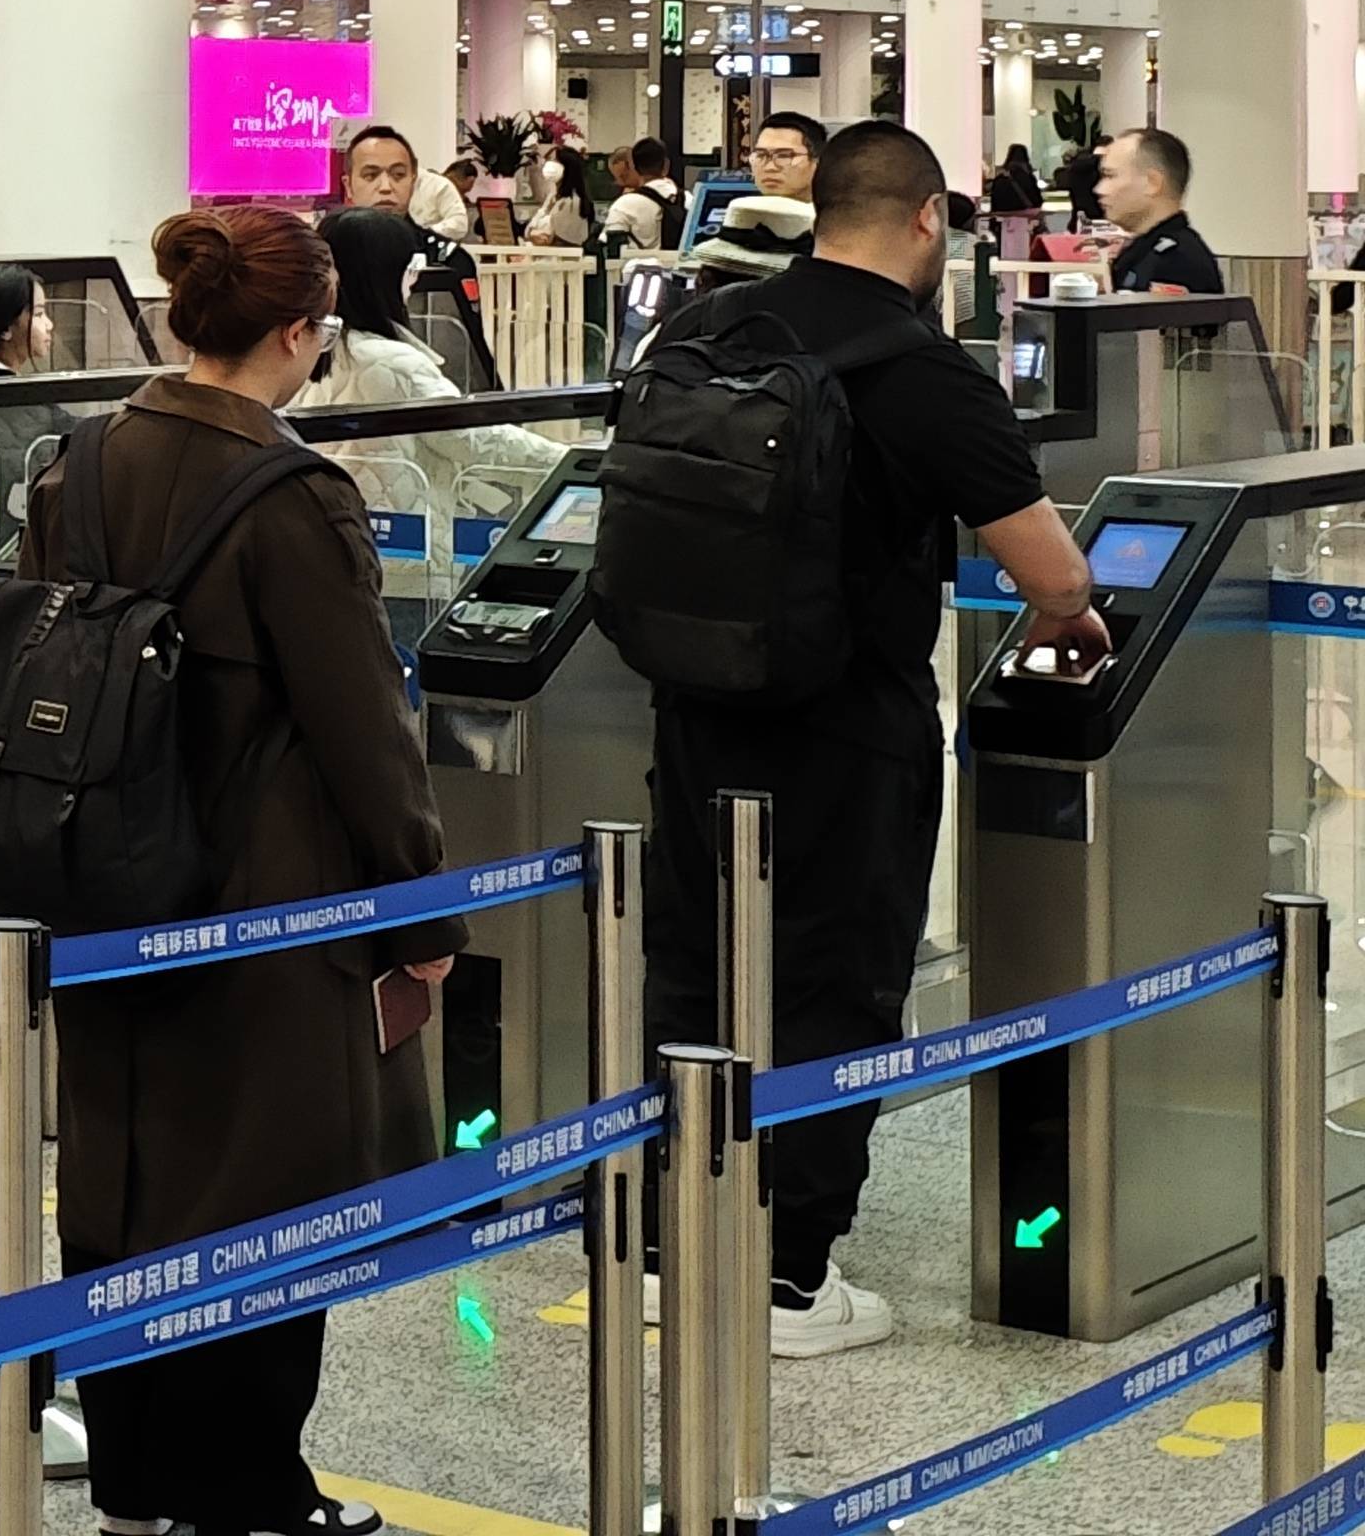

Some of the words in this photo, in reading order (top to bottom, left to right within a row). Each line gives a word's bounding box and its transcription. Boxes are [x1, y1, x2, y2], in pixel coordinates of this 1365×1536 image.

[469, 860, 545, 898] 中国移民管理
[139, 924, 227, 961] 中国移民管理
[237, 914, 280, 944] CHINA
[284, 897, 375, 937] IMMIGRATION
[1127, 963, 1194, 1008] 中国移民管理
[834, 1047, 914, 1093] 中国移民管理
[923, 1040, 962, 1068] CHINA
[965, 1013, 1046, 1057] IMMIGRATION
[497, 1121, 583, 1178] 中国移民管理
[592, 1112, 636, 1143] CHINA
[86, 1251, 200, 1318] 中国移民管理
[211, 1235, 266, 1276] CHINA
[271, 1198, 383, 1257] IMMIGRATION
[471, 1206, 545, 1248] 中国移民管理
[144, 1296, 231, 1344] 中国移民管理
[241, 1286, 285, 1317] CHINA
[289, 1259, 379, 1303] IMMIGRATION
[1122, 1350, 1188, 1404] 中国移民管理
[834, 1476, 912, 1527] 中国移民管理
[921, 1459, 960, 1490] CHINA
[964, 1421, 1043, 1472] IMMIGRATION
